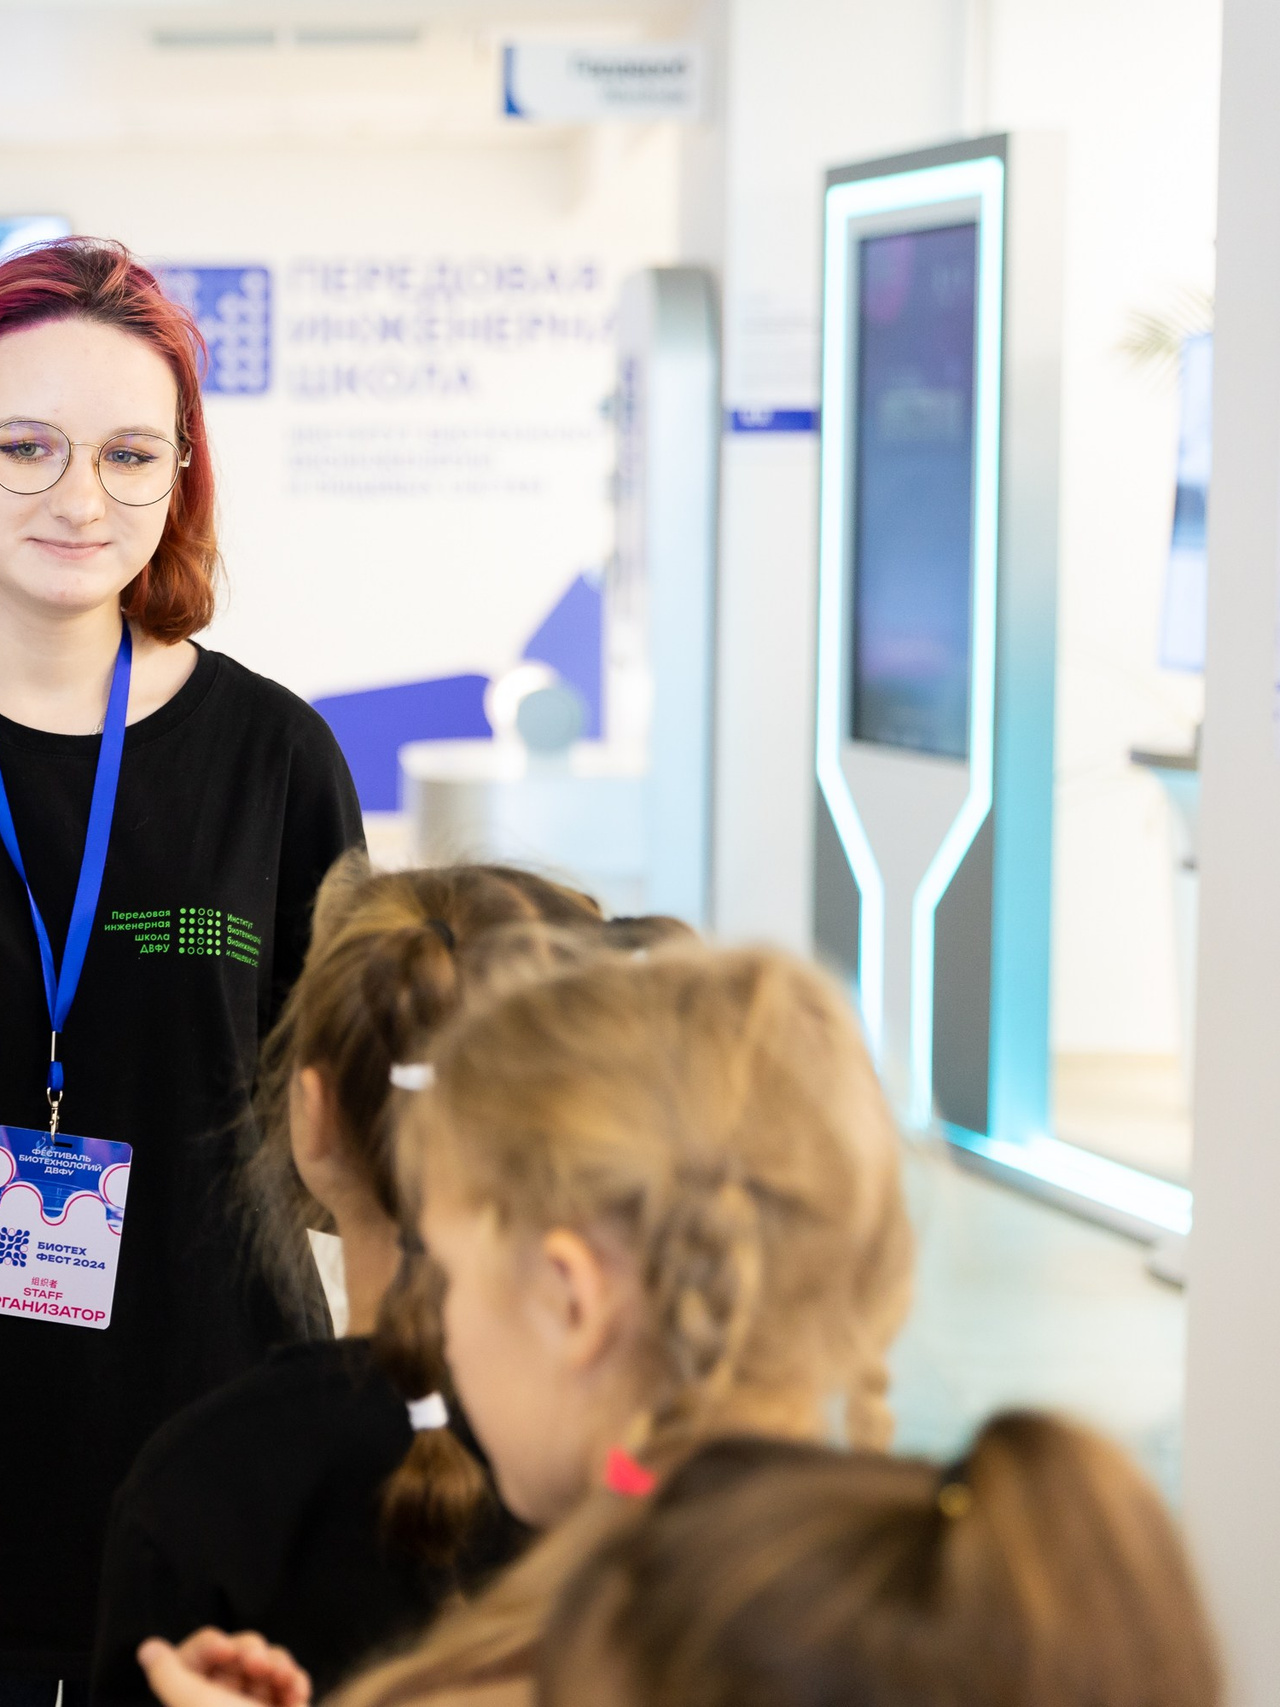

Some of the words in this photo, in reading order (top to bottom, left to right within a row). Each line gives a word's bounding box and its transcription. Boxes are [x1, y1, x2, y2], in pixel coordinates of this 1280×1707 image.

[111, 910, 171, 920] Передовая
[104, 920, 171, 931] инженерная
[135, 934, 170, 942] школа
[140, 943, 170, 954] ДВФУ
[31, 1148, 92, 1163] ФЕСТИВАЛЬ
[18, 1154, 103, 1172] БИОТЕХНОЛОГИЙ
[44, 1166, 75, 1176] ДВФУ
[37, 1241, 87, 1256] БИОТЕХ
[36, 1253, 72, 1265] ФЕСТ
[72, 1258, 106, 1270] 2024
[23, 1287, 63, 1301] STAFF
